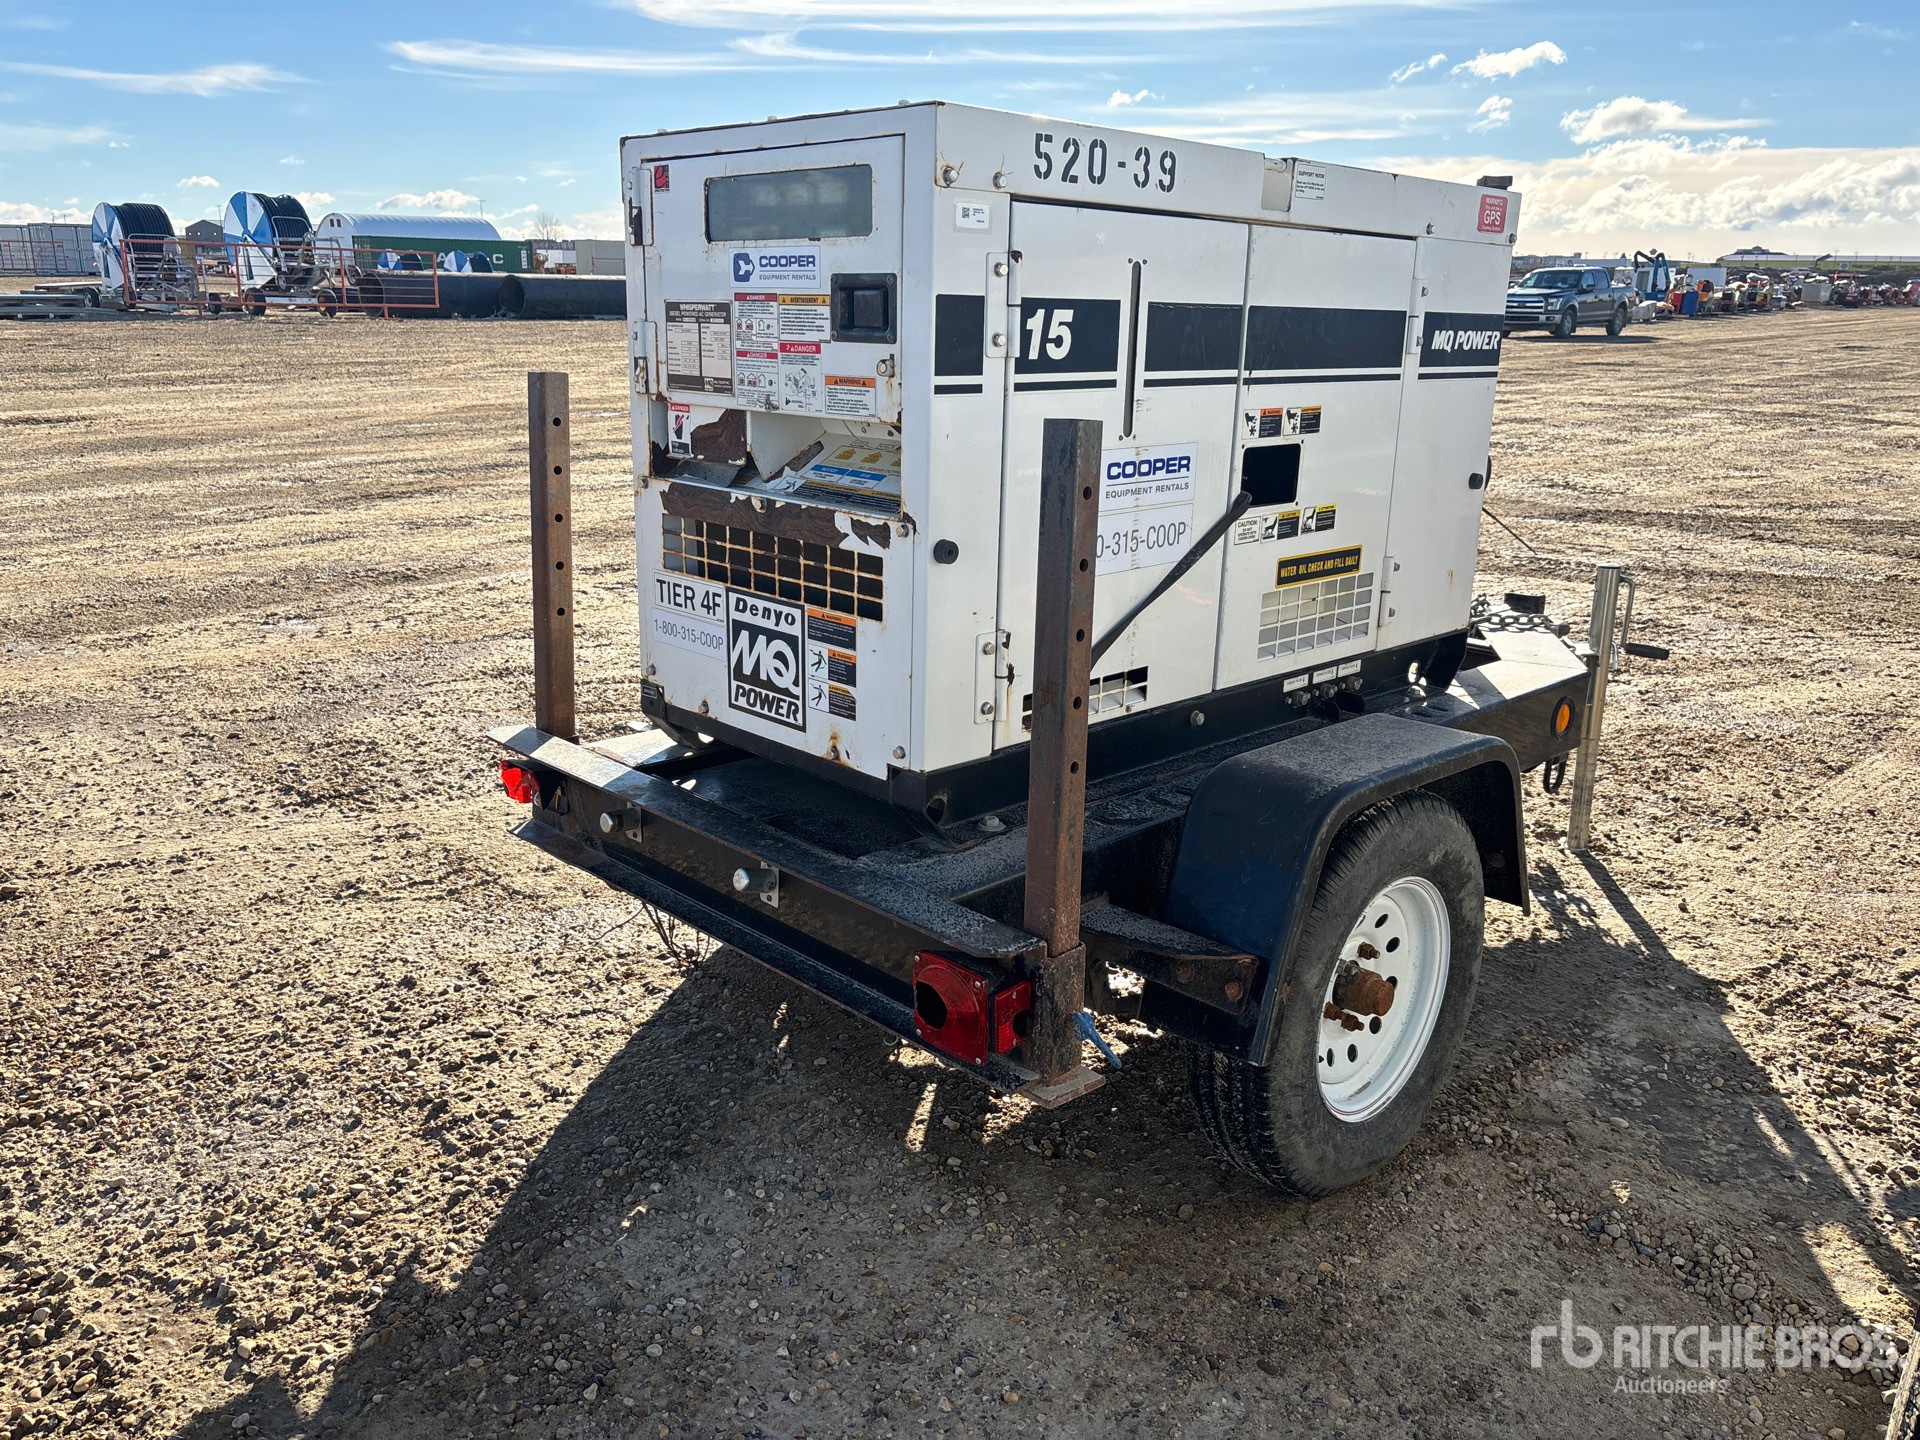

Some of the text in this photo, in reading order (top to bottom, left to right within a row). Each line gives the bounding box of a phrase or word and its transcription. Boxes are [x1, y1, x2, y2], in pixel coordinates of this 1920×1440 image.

[1033, 132, 1177, 193] 520-39
[1483, 210, 1501, 225] GPS
[759, 255, 816, 267] COOPER
[1026, 308, 1074, 360] 15
[1431, 330, 1501, 353] MQ POWER
[1106, 455, 1191, 481] COOPER
[1105, 482, 1189, 499] EQUIPMENT RENTALS
[1280, 555, 1359, 578] WATER OIL CHECK AND FILL DAILY
[656, 578, 722, 617] TIER 4F
[734, 596, 797, 628] Denyo
[654, 618, 724, 650] 1-800-315-COOP
[733, 629, 800, 696] MQ
[734, 683, 800, 722] POWER
